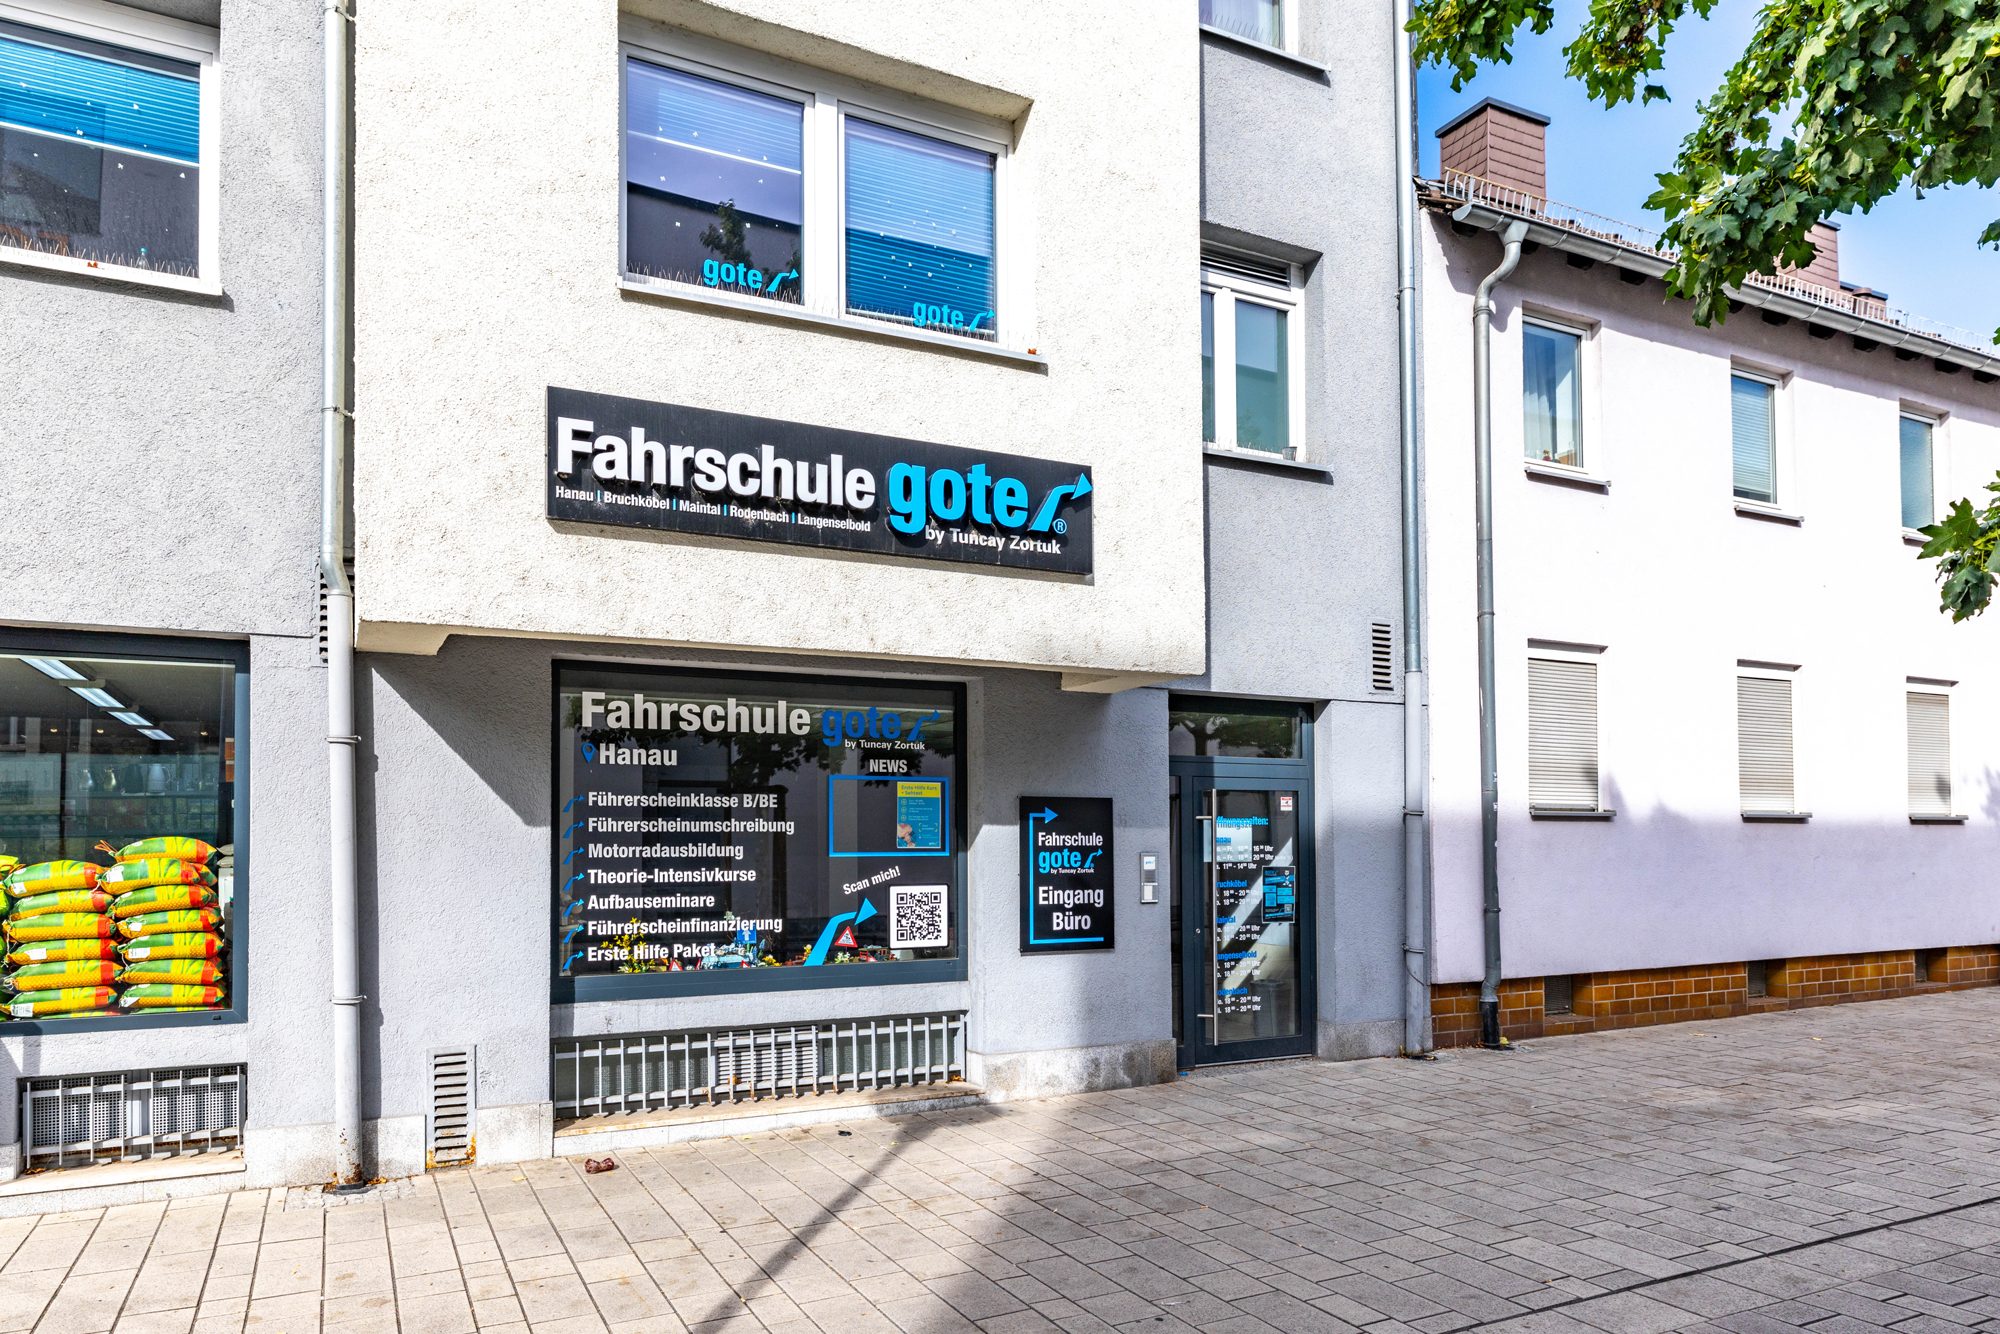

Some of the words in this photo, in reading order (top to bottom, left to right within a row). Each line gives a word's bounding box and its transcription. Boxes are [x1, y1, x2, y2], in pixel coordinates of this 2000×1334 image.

[703, 258, 763, 289] gote
[913, 301, 964, 328] gote
[556, 416, 876, 510] Fahrschule
[888, 462, 1029, 534] gote
[555, 485, 594, 502] Hanau
[604, 491, 671, 510] Bruchköbel
[679, 500, 721, 516] Maintal
[729, 505, 790, 524] Rodenbach
[797, 513, 871, 532] Langenselbold
[925, 524, 946, 545] by
[949, 527, 1006, 551] Tuncay
[1009, 535, 1062, 555] Zortuk
[581, 691, 812, 736] Fahrschule
[822, 706, 902, 748] gote
[844, 739, 857, 749] by
[859, 739, 893, 751] Tuncay
[894, 741, 926, 750] Zortuk
[599, 743, 678, 767] Hanau
[869, 759, 908, 773] NEWS
[588, 791, 739, 808] Führerscheinklasse
[743, 793, 778, 809] B/BE
[588, 817, 795, 835] Führerscheinumschreibung
[1216, 815, 1269, 826] ffnungszeiten:
[1038, 831, 1103, 847] Fahrschule
[588, 843, 744, 860] Motorradausbildung
[1038, 848, 1082, 874] gote
[587, 868, 757, 884] Theorie-Intensivkurse
[842, 877, 871, 896] Scan
[871, 865, 902, 886] mich!
[1216, 880, 1248, 888] ruchköbel
[587, 893, 715, 910] Aufbauseminare
[1038, 886, 1104, 909] Eingang
[587, 916, 783, 936] Führerscheinfinanzierung
[1052, 912, 1091, 931] Büro
[588, 946, 629, 962] Erste
[633, 944, 669, 960] Hilfe
[673, 943, 716, 959] Paket
[1216, 950, 1257, 961] angenselbold
[1216, 987, 1248, 996] odenbach
